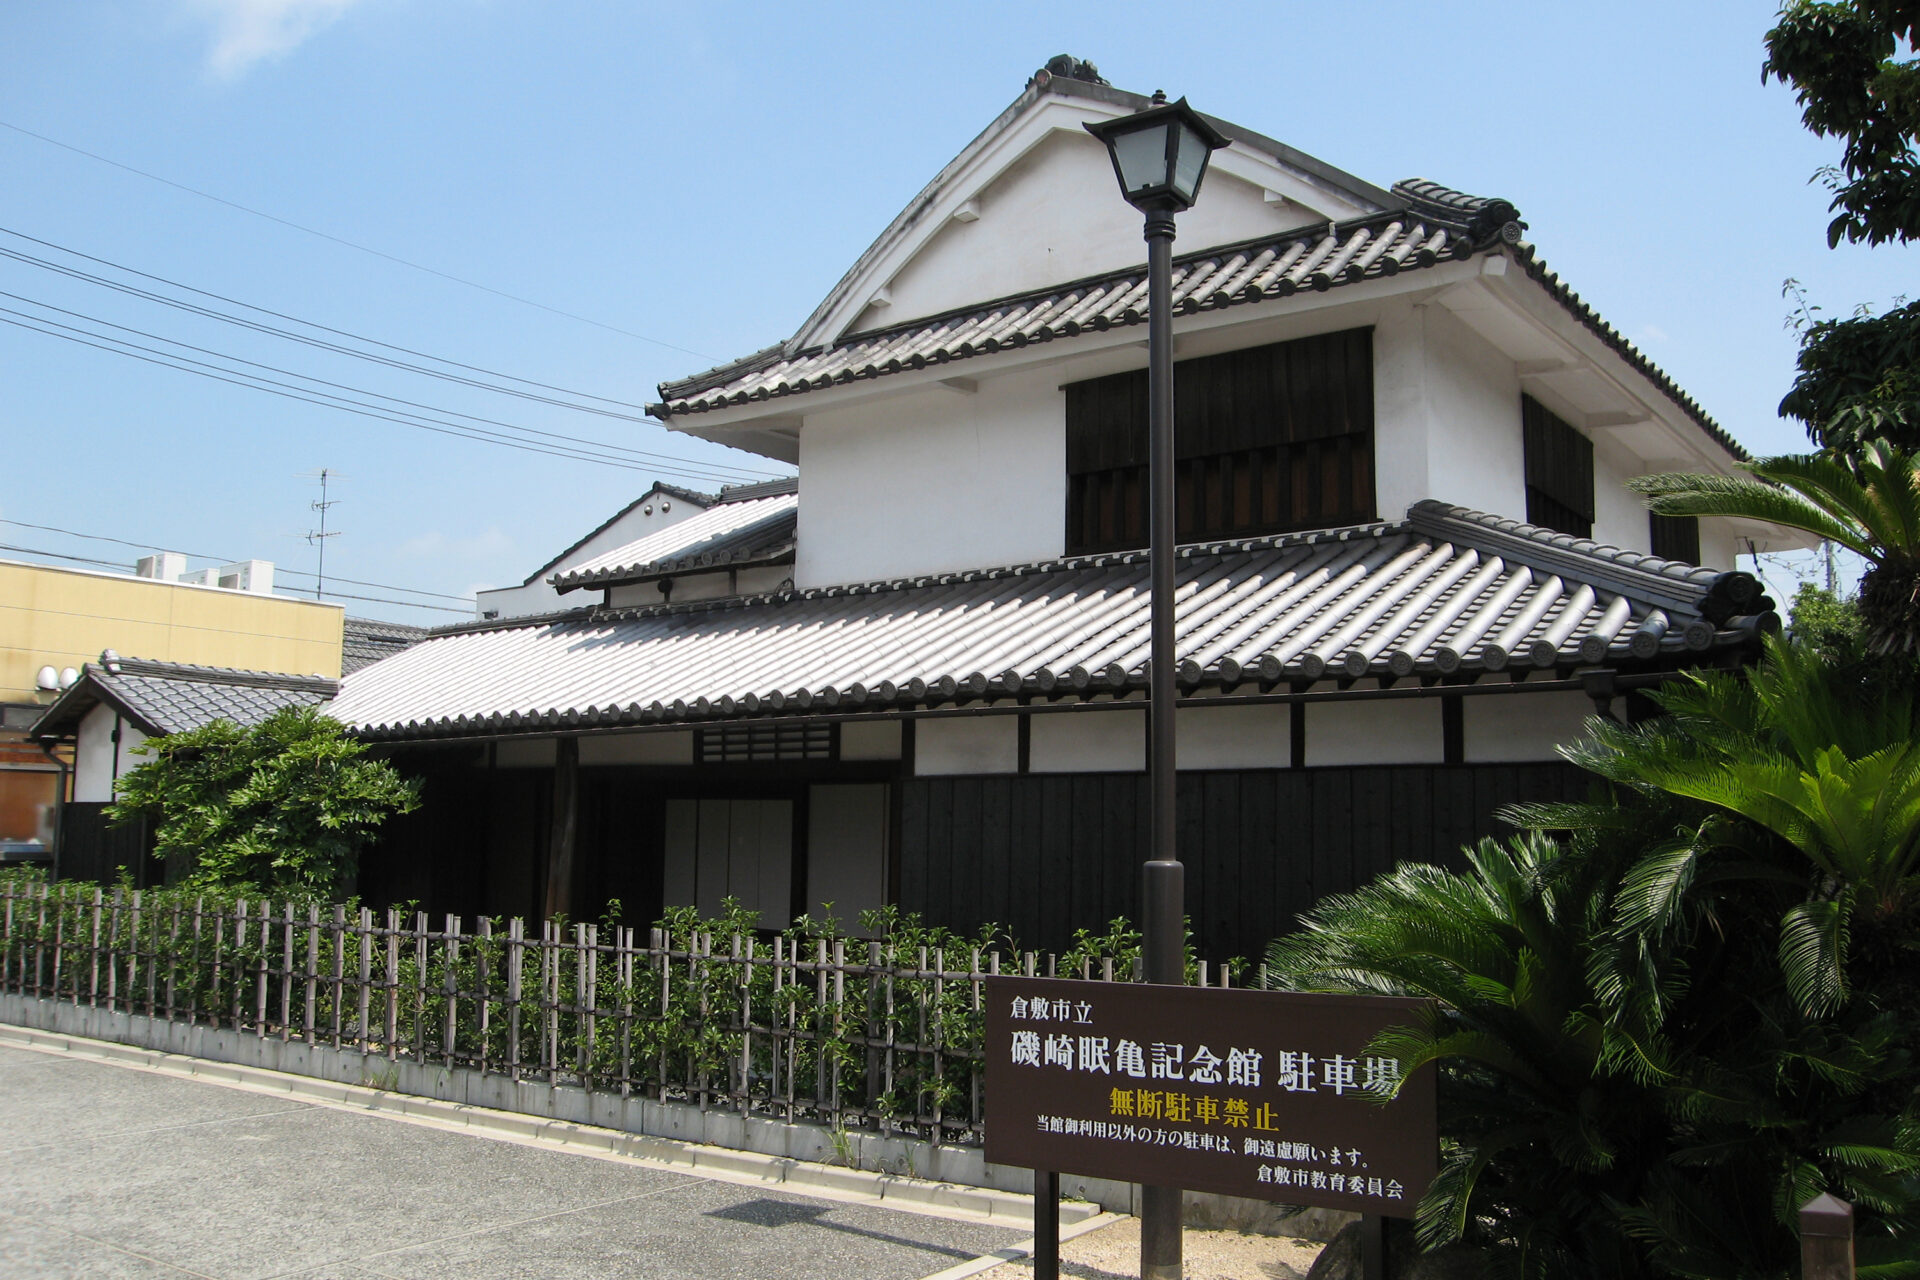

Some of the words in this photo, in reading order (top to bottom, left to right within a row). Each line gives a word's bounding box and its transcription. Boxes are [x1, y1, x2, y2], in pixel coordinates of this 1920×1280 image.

[1010, 995, 1093, 1024] 倉敷市立
[1010, 1030, 1263, 1087] 磯崎眠亀記念館
[1277, 1050, 1400, 1099] 駐車場
[1109, 1087, 1279, 1132] 無断駐車禁止
[1257, 1165, 1404, 1200] 倉敷市教育委員会
